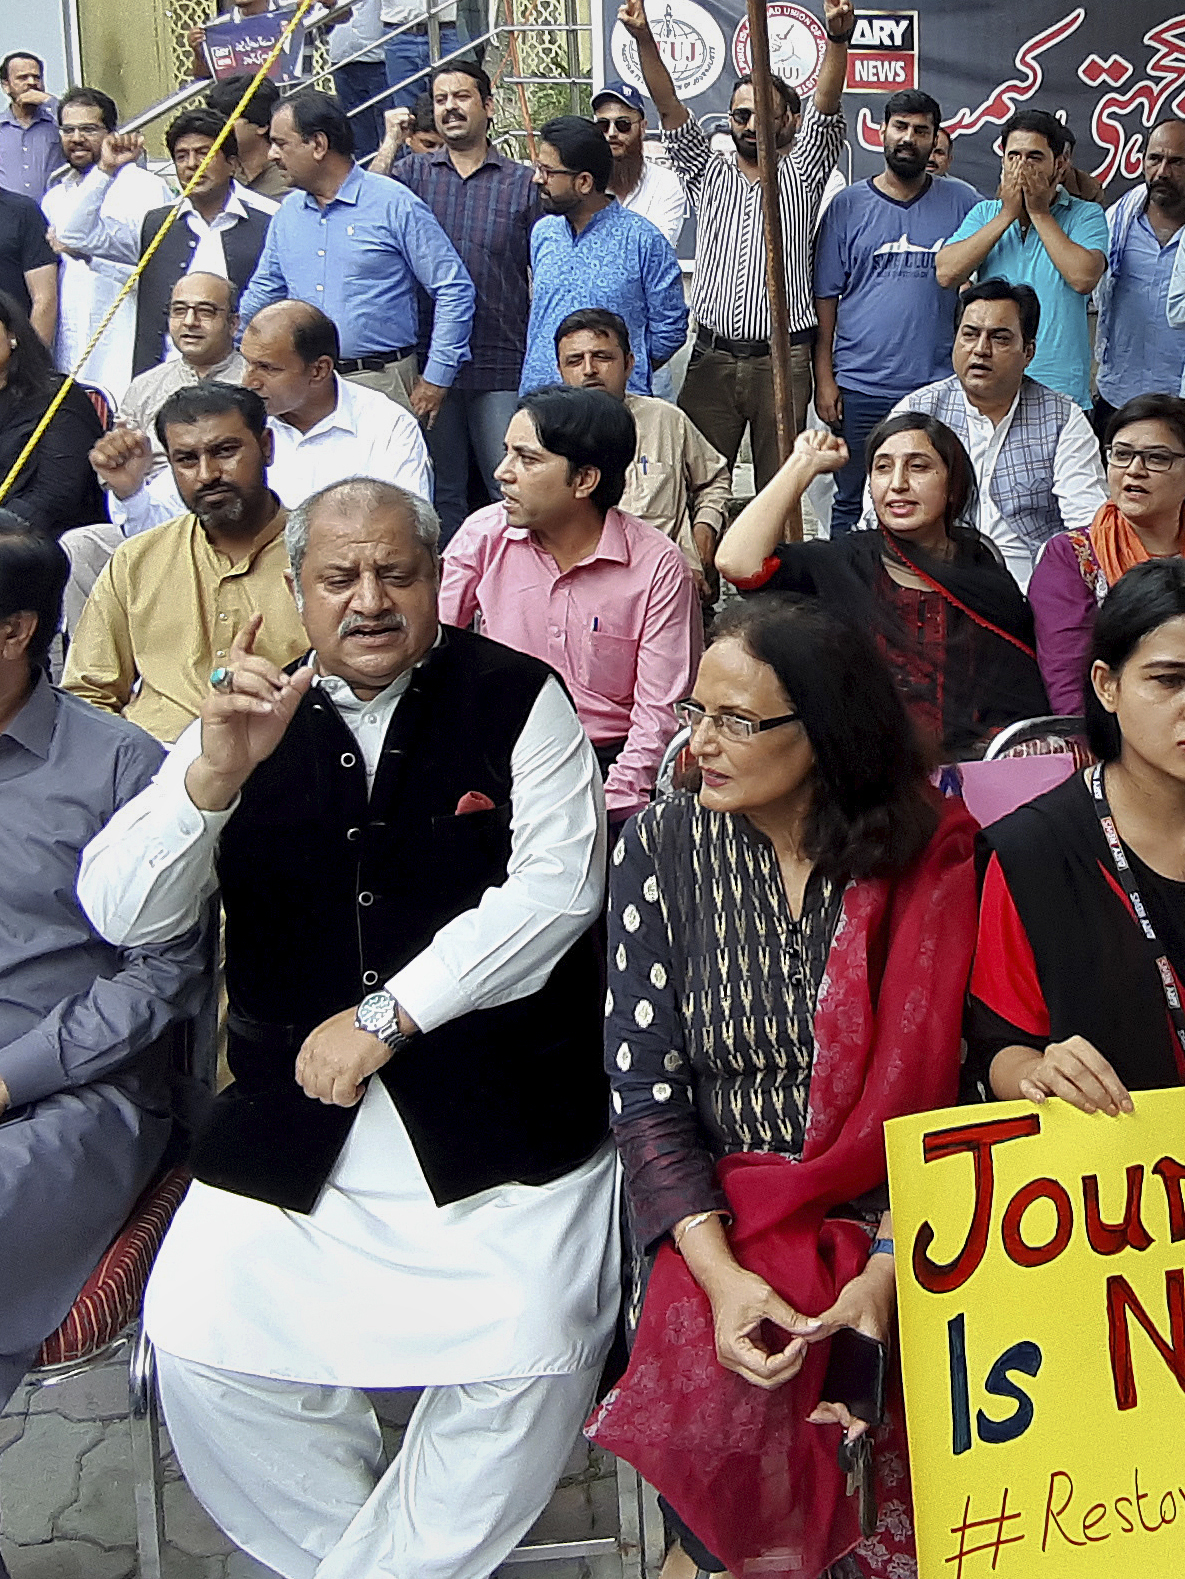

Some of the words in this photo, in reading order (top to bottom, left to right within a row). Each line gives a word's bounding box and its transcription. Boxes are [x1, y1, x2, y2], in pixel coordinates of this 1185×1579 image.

[851, 19, 910, 46] ARY
[655, 40, 696, 62] FUJ
[855, 60, 906, 82] NEWS
[947, 1313, 1042, 1456] Is
